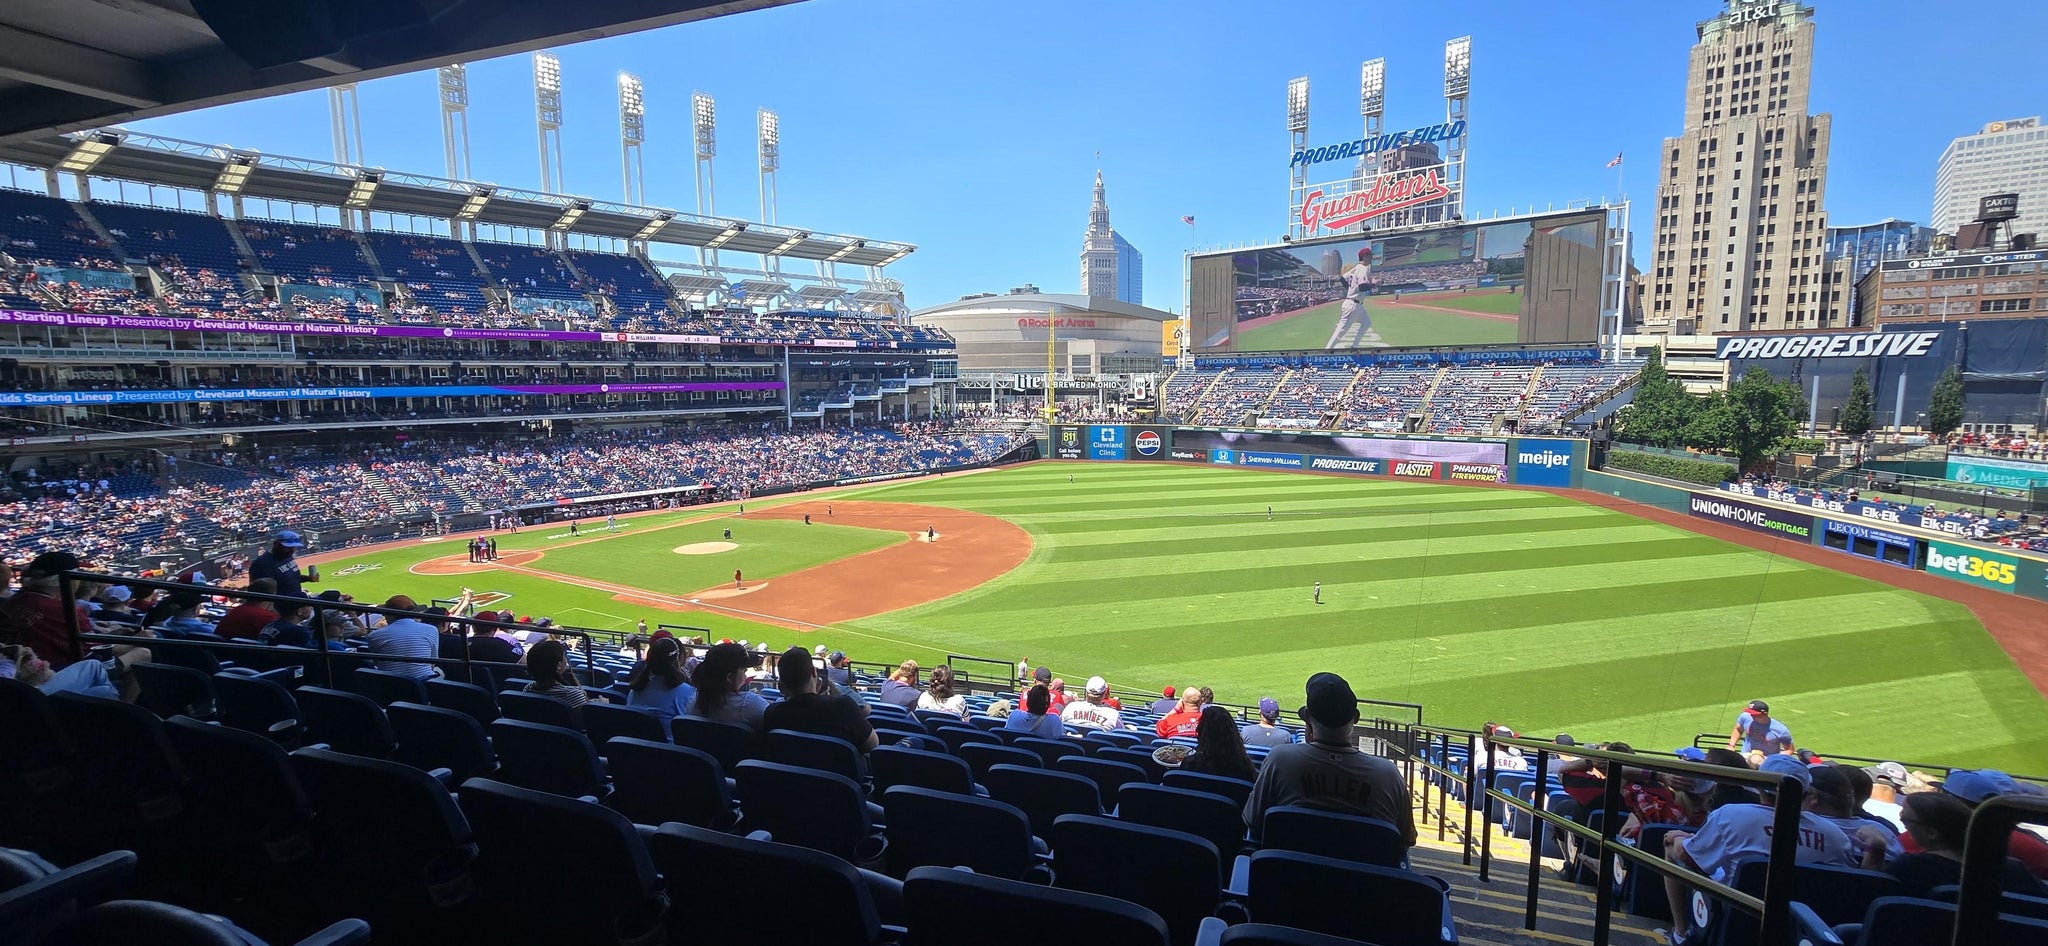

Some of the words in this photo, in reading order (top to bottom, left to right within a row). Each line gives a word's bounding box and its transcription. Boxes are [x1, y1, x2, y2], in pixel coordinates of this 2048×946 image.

[1729, 0, 1778, 25] at&t
[2006, 118, 2035, 131] PNC
[1290, 131, 1408, 168] PROGRESSIVE
[1408, 120, 1466, 146] FIELD
[1300, 169, 1450, 234] Guardians
[14, 312, 65, 325] Starting
[67, 314, 108, 327] Lineup
[111, 316, 175, 327] Presented
[176, 318, 191, 330] by
[193, 320, 246, 330] Cleveland
[248, 322, 292, 332] Museum
[293, 324, 304, 332] of
[306, 324, 342, 333] Natural
[344, 325, 378, 336] History
[1066, 319, 1095, 328] Arena
[1718, 332, 1939, 359] PROGRESSIVE
[1313, 355, 1354, 363] HONDA
[1387, 353, 1432, 361] HONDA
[1470, 351, 1522, 359] HONDA
[1538, 350, 1593, 358] HONDA
[1014, 373, 1043, 391] Lite
[1054, 381, 1086, 389] BREWED
[1097, 381, 1117, 389] OHIO
[24, 393, 72, 404] Starting
[74, 392, 113, 403] Lineup
[116, 391, 177, 401] Presented
[178, 390, 192, 402] by
[194, 390, 245, 399] Cleveland
[246, 389, 288, 398] Museum
[290, 389, 301, 397] of
[302, 388, 337, 397] Natural
[338, 389, 371, 398] History
[1063, 432, 1076, 442] 811
[1099, 449, 1117, 457] Clinic
[1171, 451, 1194, 459] KeyBank
[1518, 450, 1570, 468] meijer
[1311, 458, 1379, 472] PROGRESSIVE
[1394, 462, 1434, 477] BLASTER
[1452, 465, 1497, 474] PHANTOM
[1452, 472, 1497, 481] FIREWORKS
[1764, 519, 1808, 537] MORTGAGE
[1927, 546, 2016, 585] bet365
[1300, 770, 1372, 806] MILLER
